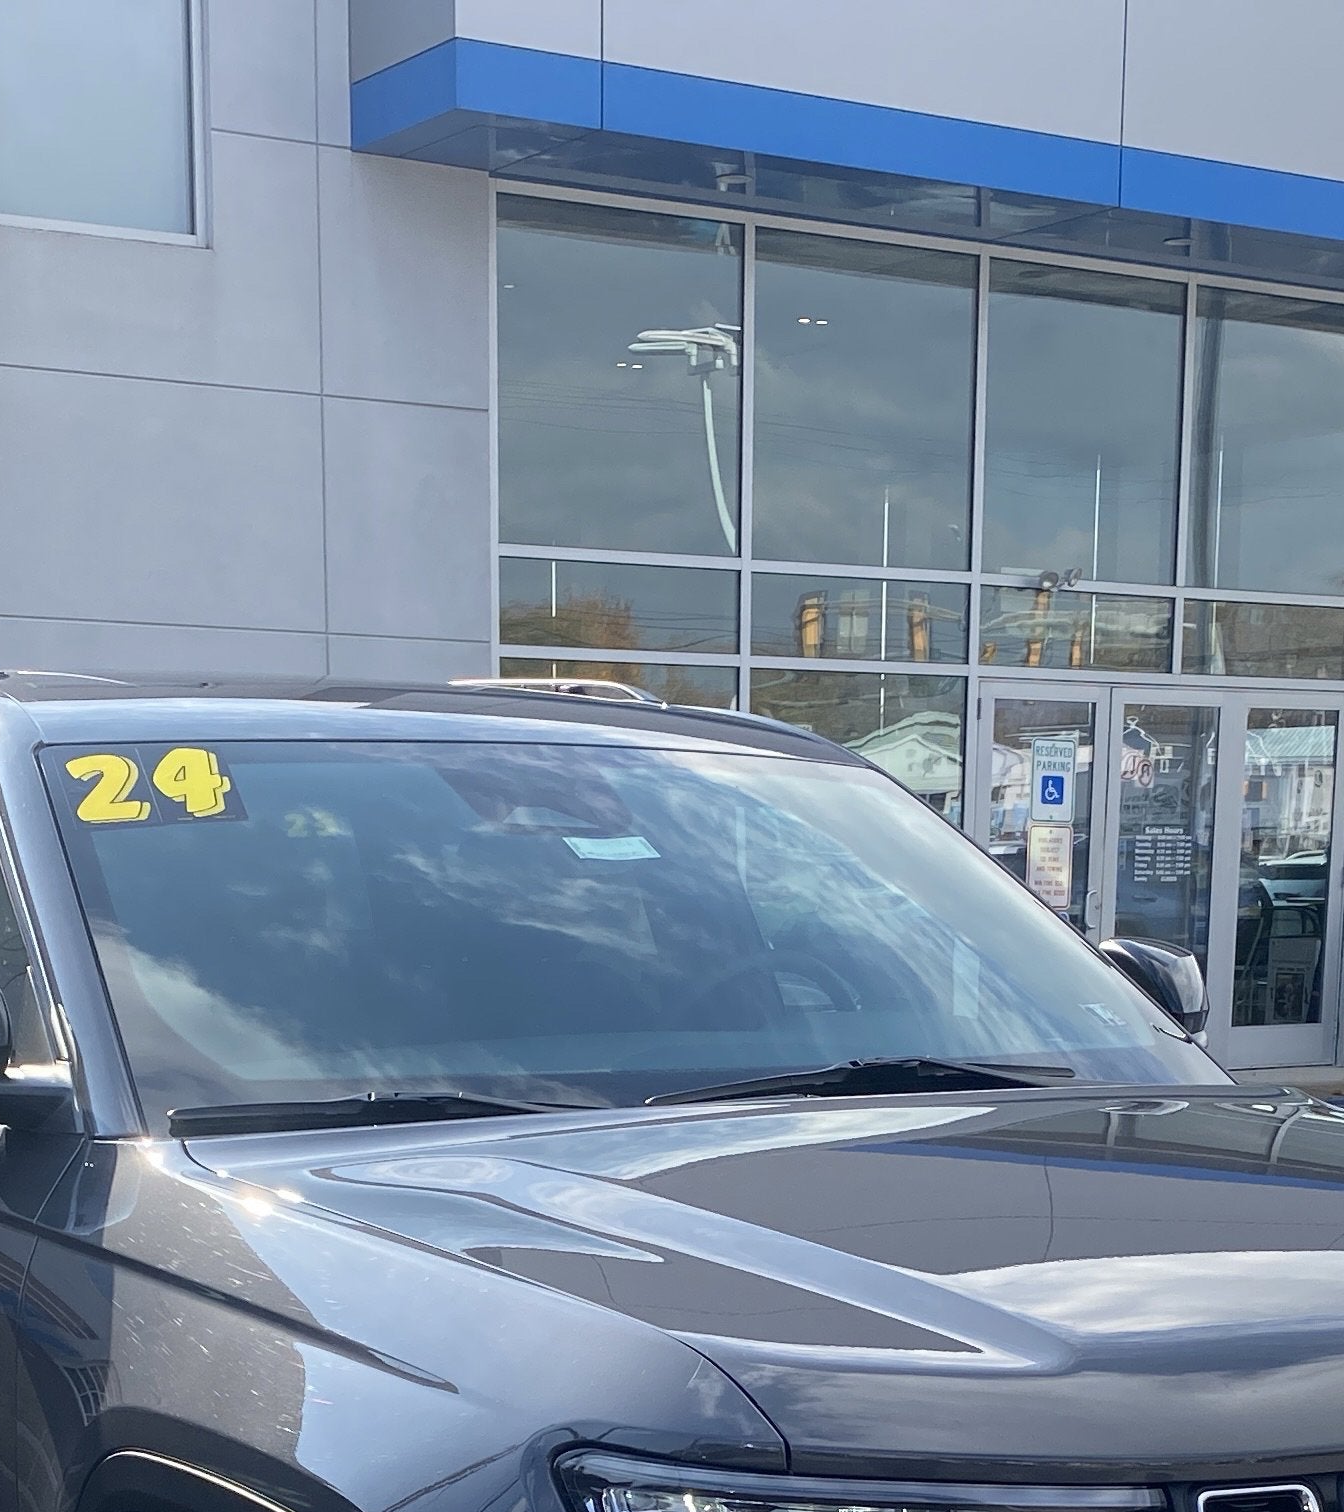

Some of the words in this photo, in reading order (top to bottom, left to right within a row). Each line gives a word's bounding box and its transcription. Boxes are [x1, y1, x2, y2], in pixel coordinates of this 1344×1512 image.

[1036, 744, 1073, 758] RESERVED
[1036, 760, 1071, 772] PARKING
[65, 747, 231, 824] 24
[1145, 826, 1163, 834] Sales
[1164, 826, 1184, 834] Hours
